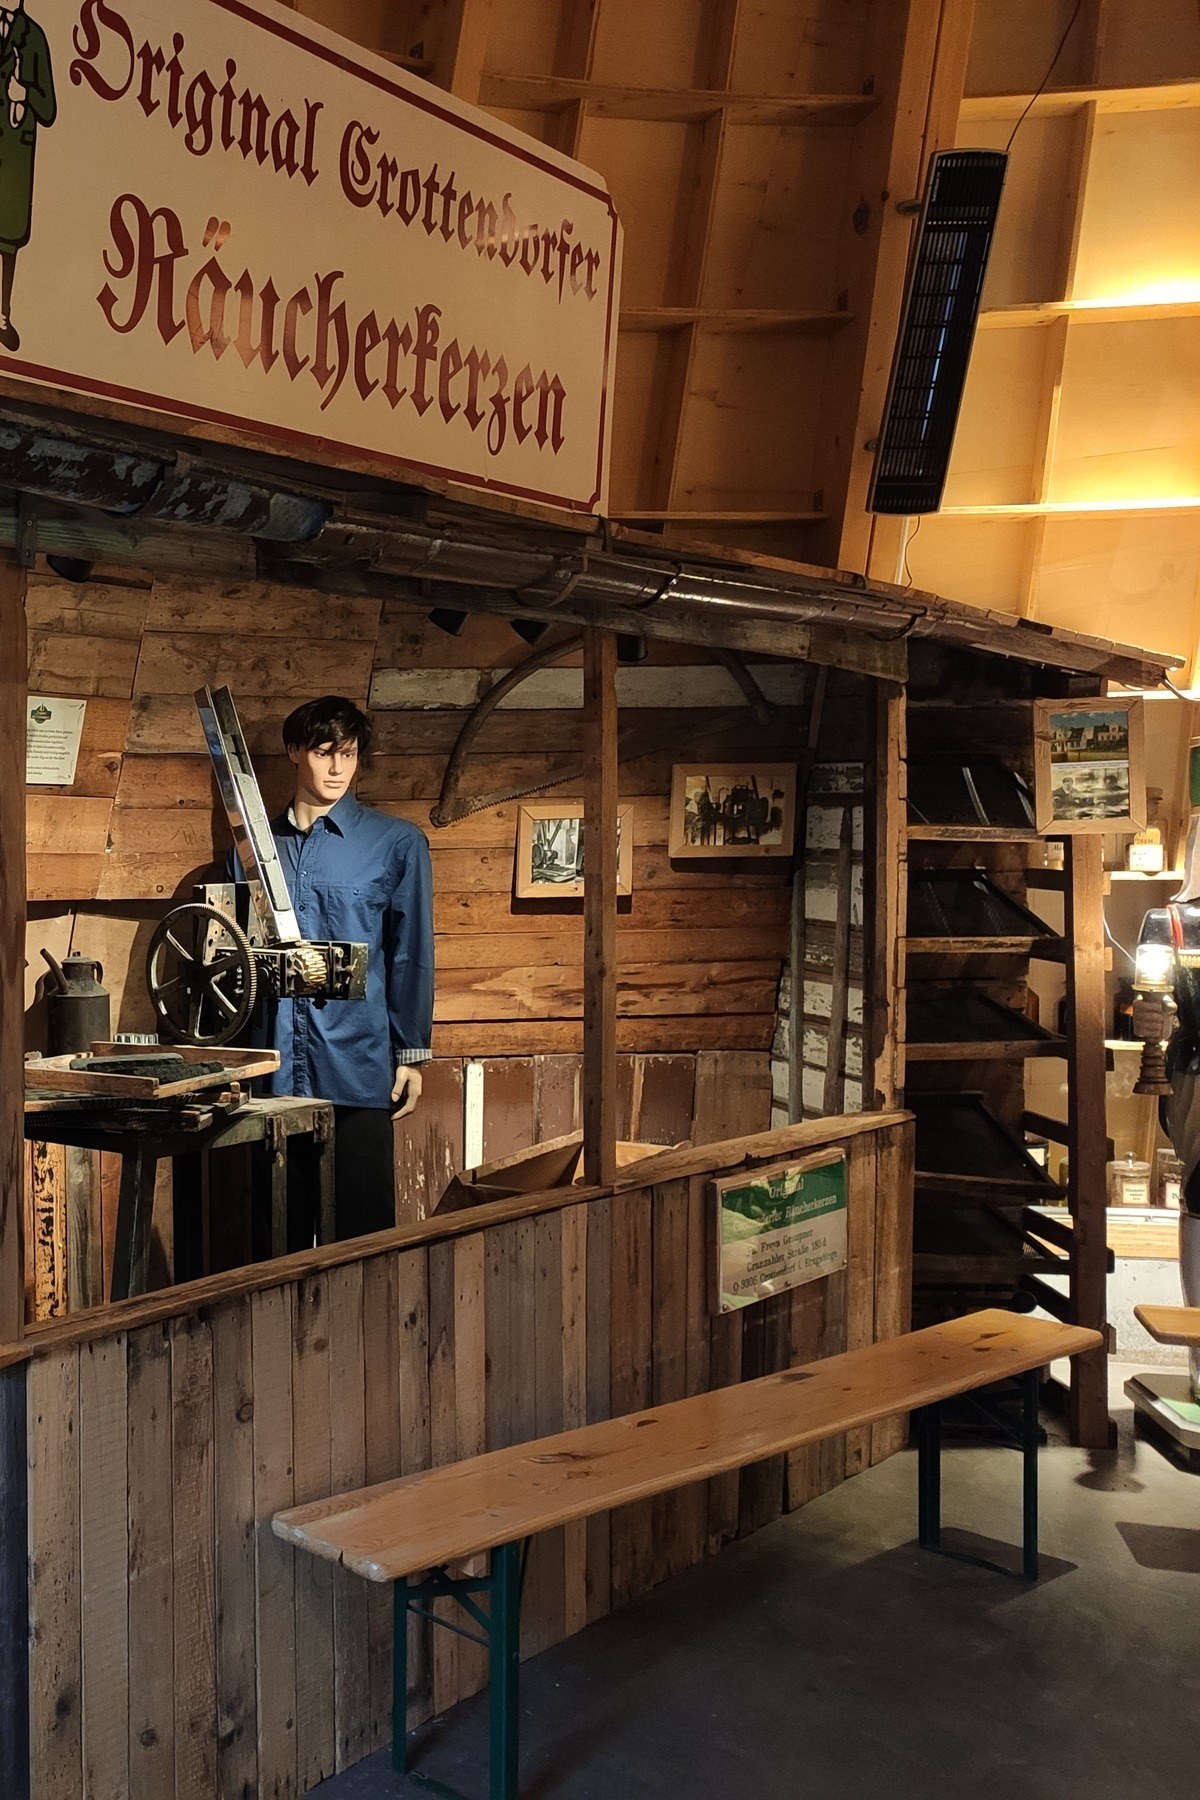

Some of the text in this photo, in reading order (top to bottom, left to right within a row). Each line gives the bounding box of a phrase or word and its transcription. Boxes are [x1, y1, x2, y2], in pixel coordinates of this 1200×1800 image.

[70, 0, 600, 305] Original Crottendorfer
[96, 193, 566, 456] Räucherkerzen
